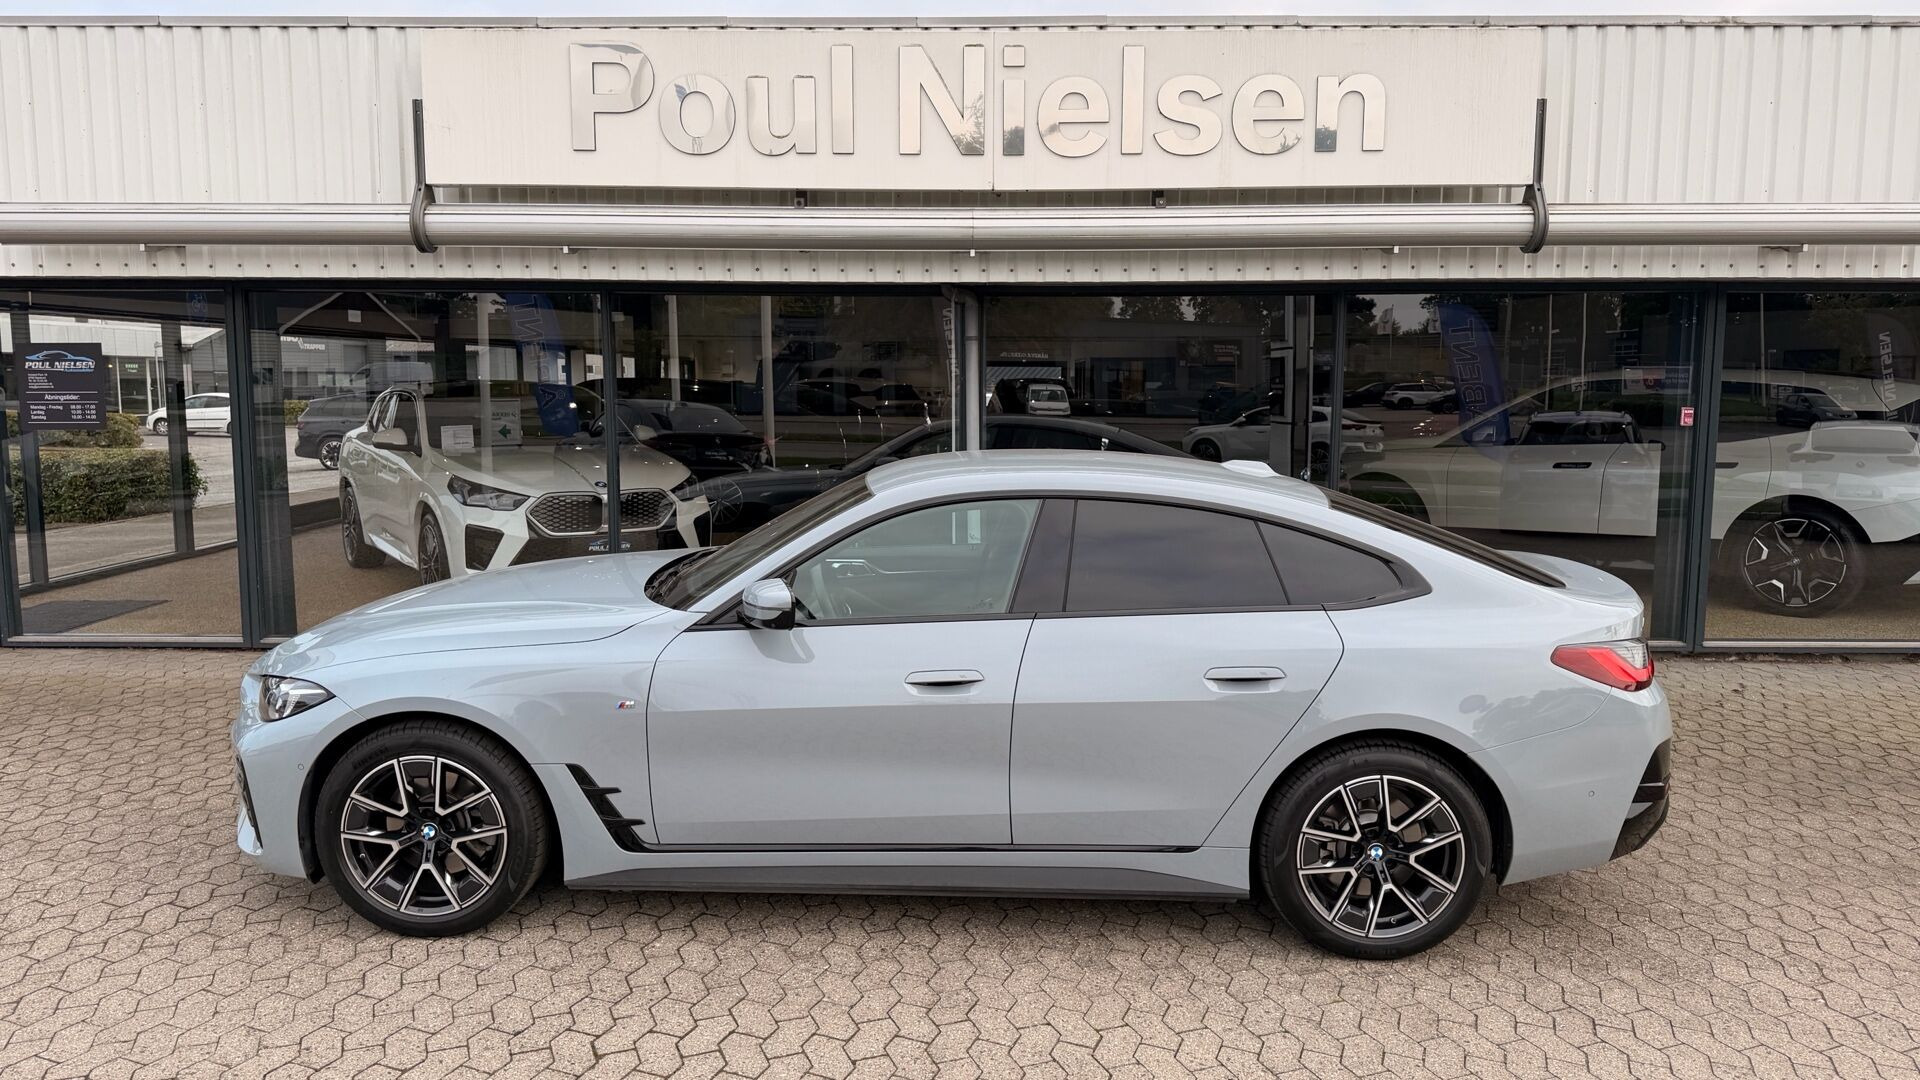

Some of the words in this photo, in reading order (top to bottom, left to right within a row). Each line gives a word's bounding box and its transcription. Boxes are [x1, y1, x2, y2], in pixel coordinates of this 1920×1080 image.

[569, 42, 855, 156] Poul
[899, 43, 1387, 158] Nielsen
[24, 361, 52, 369] POUL
[53, 361, 95, 369] NIELSEN
